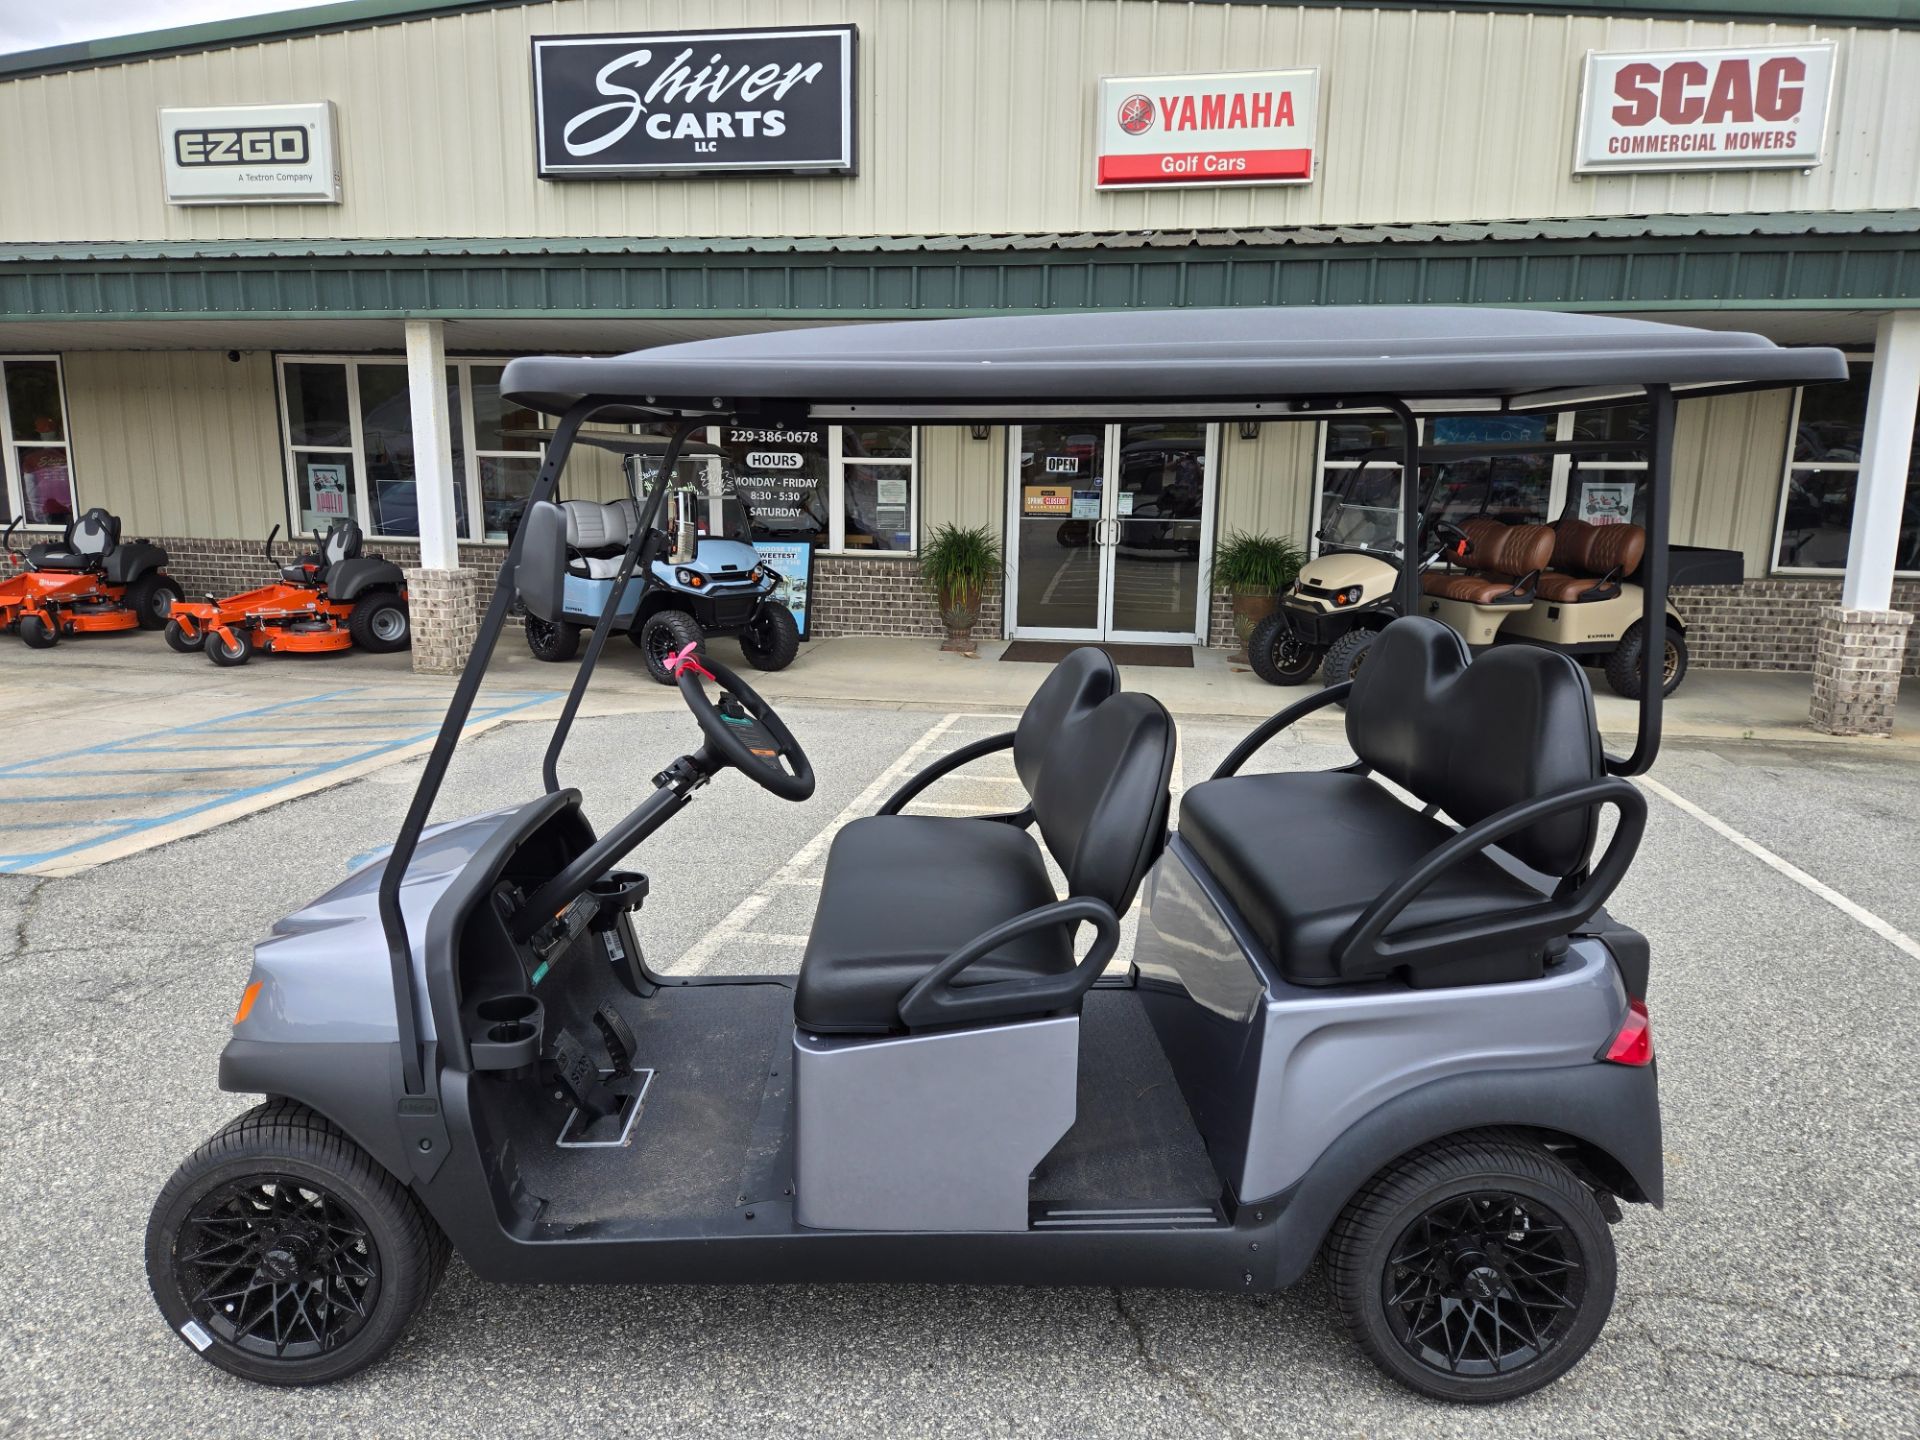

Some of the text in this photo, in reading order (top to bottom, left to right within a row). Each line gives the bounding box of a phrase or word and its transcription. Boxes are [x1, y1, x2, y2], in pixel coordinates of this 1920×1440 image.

[1611, 57, 1807, 127] SCAG
[563, 47, 823, 157] Shiver
[1159, 91, 1295, 132] YAMAHA
[645, 109, 786, 139] CARTS
[694, 141, 717, 153] LLC
[1608, 131, 1797, 154] COMMERCIAL MOWERS
[1161, 154, 1246, 173] Golf Cars
[238, 172, 313, 183] A Textron Company
[730, 430, 819, 443] 229-386-0678
[1449, 430, 1531, 441] VALOR
[752, 454, 798, 467] HOURS
[1048, 457, 1077, 471] OPEN
[735, 476, 776, 487] MONDAY
[783, 478, 819, 488] FRIDAY
[750, 491, 772, 500] 8:30
[779, 491, 800, 501] 5:30
[749, 506, 801, 517] SATURDAY
